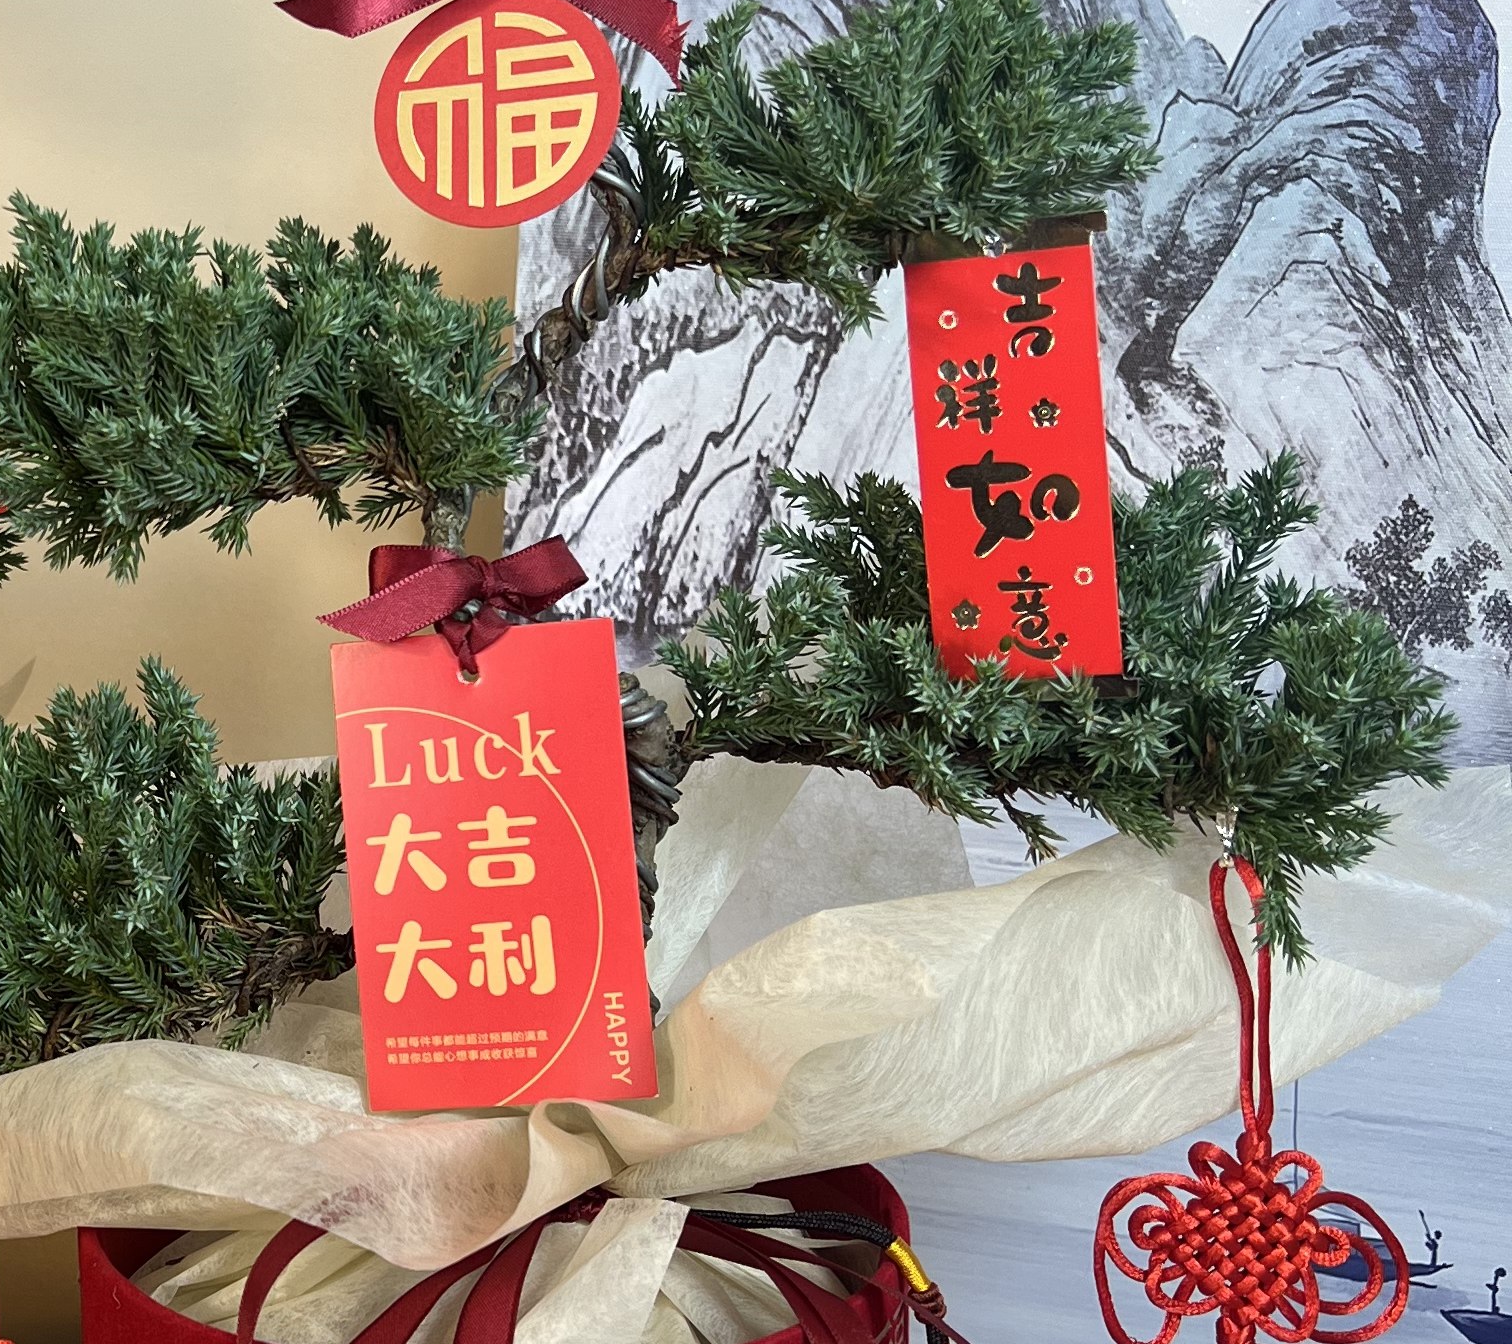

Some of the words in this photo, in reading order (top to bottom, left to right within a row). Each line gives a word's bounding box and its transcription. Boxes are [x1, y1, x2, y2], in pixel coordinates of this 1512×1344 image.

[397, 11, 598, 207] 福
[934, 261, 1081, 662] 吉祥如意
[364, 711, 561, 789] Luck
[366, 806, 538, 896] 大吉
[376, 914, 557, 1003] 大利
[603, 991, 633, 1086] HAPPY
